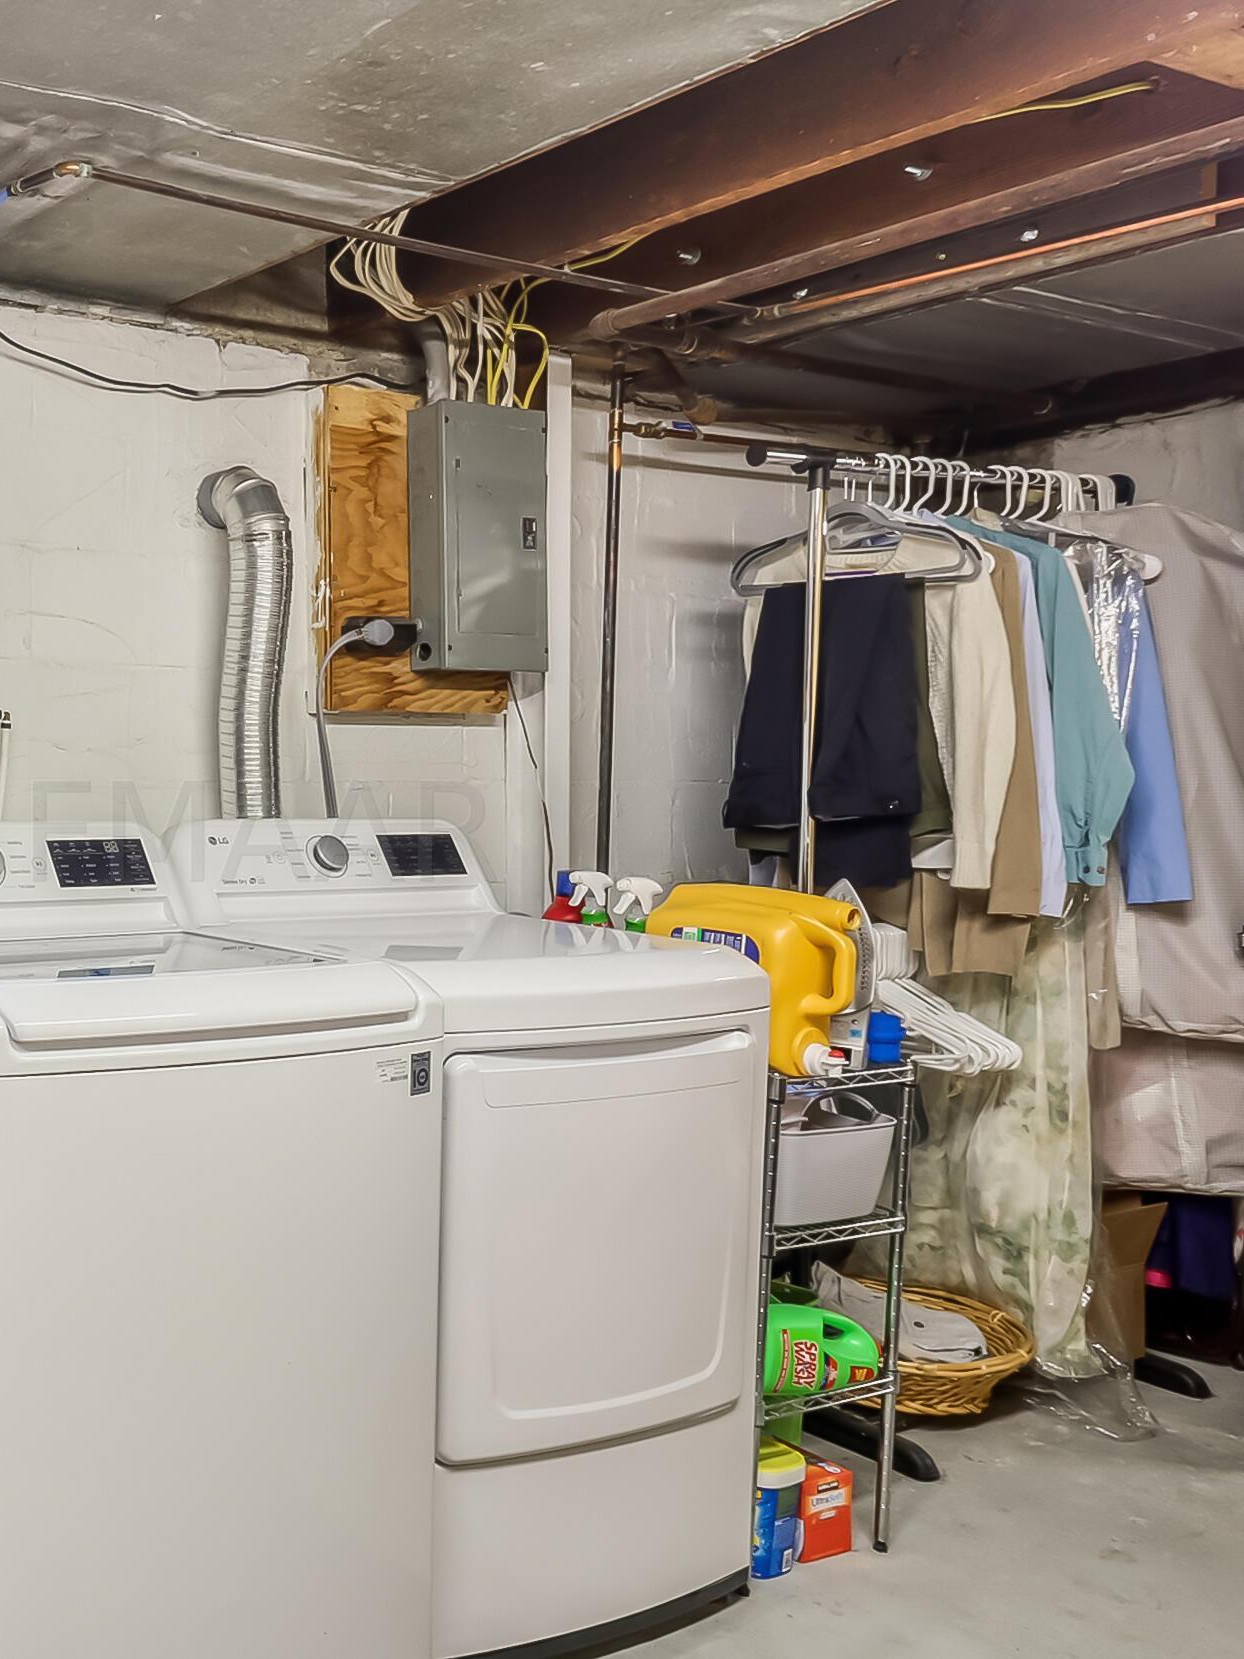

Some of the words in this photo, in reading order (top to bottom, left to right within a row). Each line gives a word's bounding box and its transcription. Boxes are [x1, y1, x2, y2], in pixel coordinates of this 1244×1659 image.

[218, 837, 230, 846] LG
[793, 1341, 806, 1386] WASH
[803, 1341, 818, 1390] SPRAY
